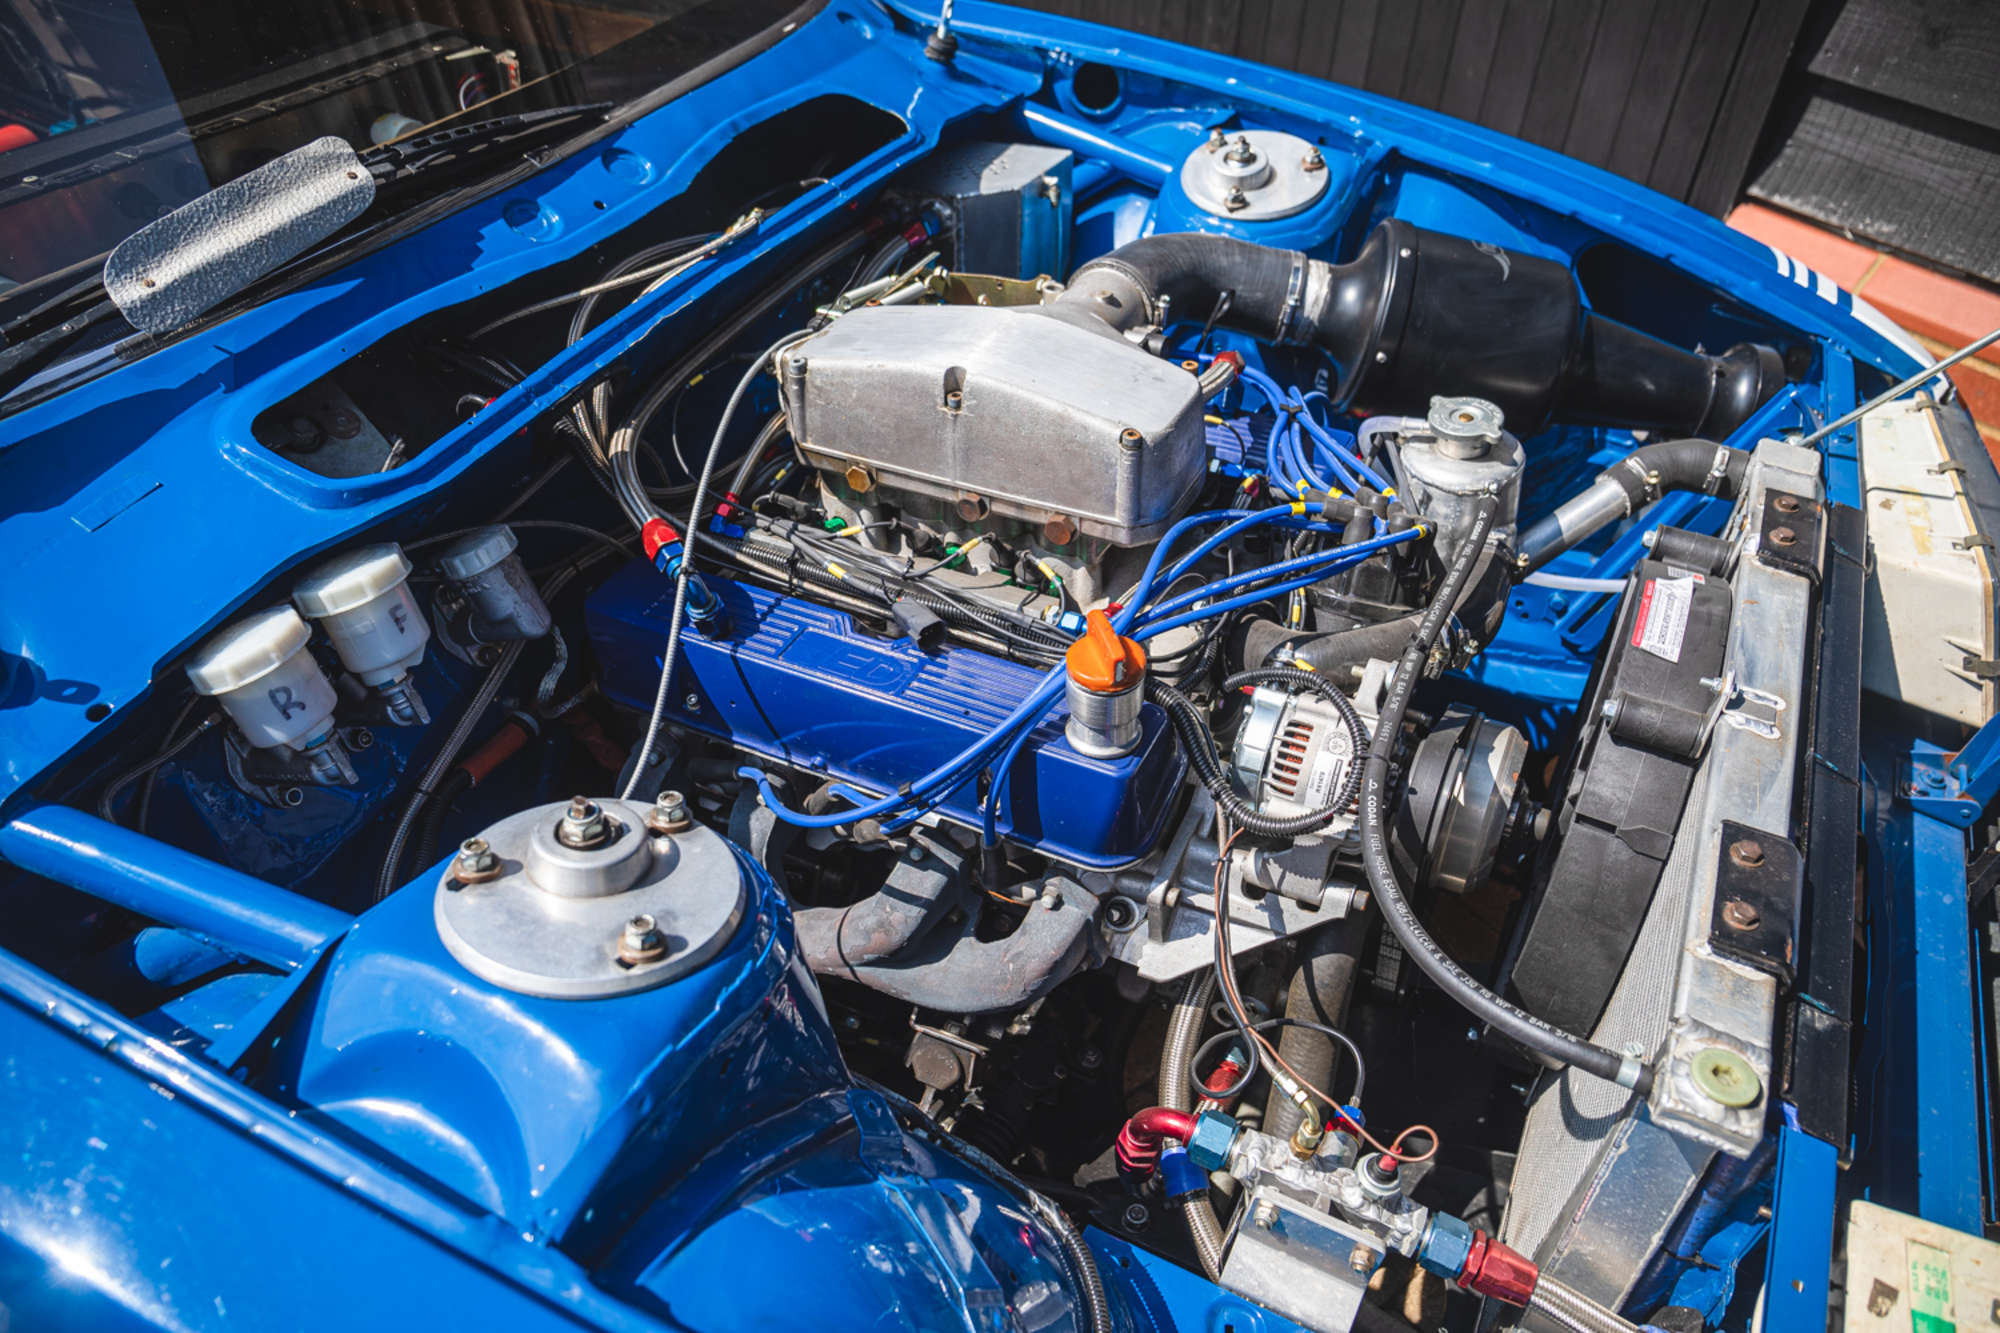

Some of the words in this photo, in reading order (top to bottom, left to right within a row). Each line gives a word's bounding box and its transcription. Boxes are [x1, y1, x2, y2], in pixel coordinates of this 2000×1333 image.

[388, 605, 408, 635] F
[268, 686, 306, 721] R
[1367, 795, 1377, 825] CODAN
[1369, 833, 1381, 852] FUEL
[1374, 854, 1389, 876] HOSE
[1433, 950, 1442, 960] &
[1441, 958, 1459, 975] SAE
[1494, 996, 1511, 1010] WP
[1513, 1008, 1526, 1018] 12
[1527, 1015, 1552, 1032] BAR
